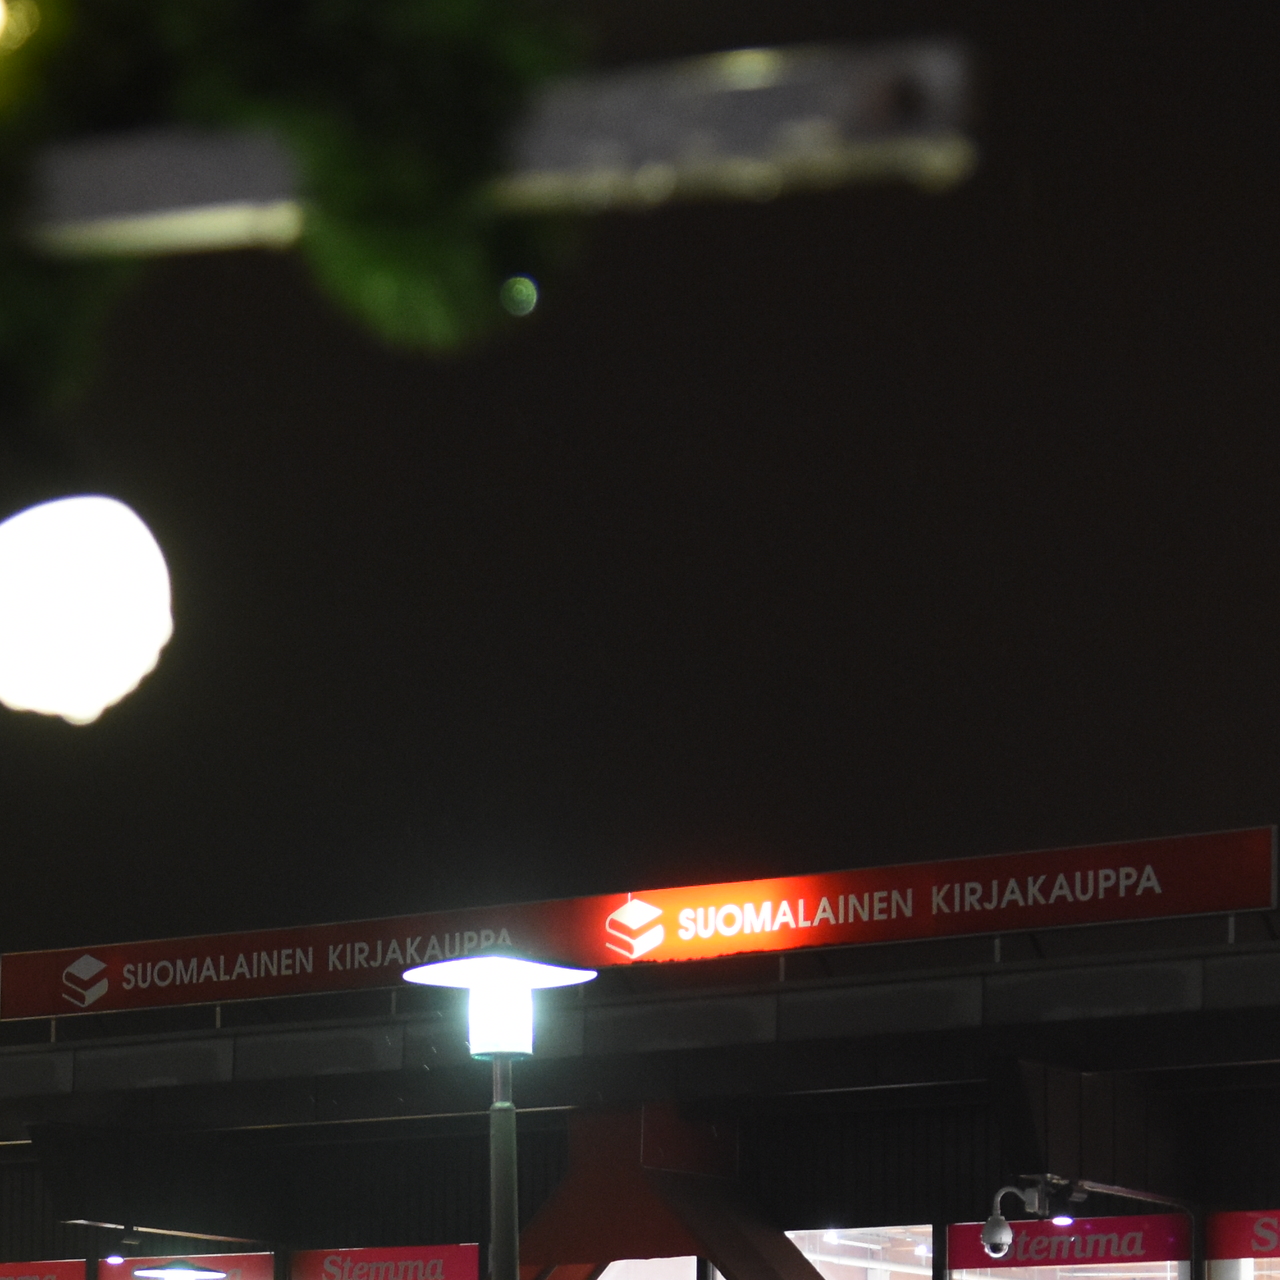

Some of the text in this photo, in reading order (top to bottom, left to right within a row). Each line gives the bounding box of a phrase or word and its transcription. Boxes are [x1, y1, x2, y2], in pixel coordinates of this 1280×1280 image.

[678, 866, 1161, 940] SUOMALAINEN KIRJAKAUPPA
[122, 927, 512, 989] SUOMALAINEN KIRJAKAUPPA
